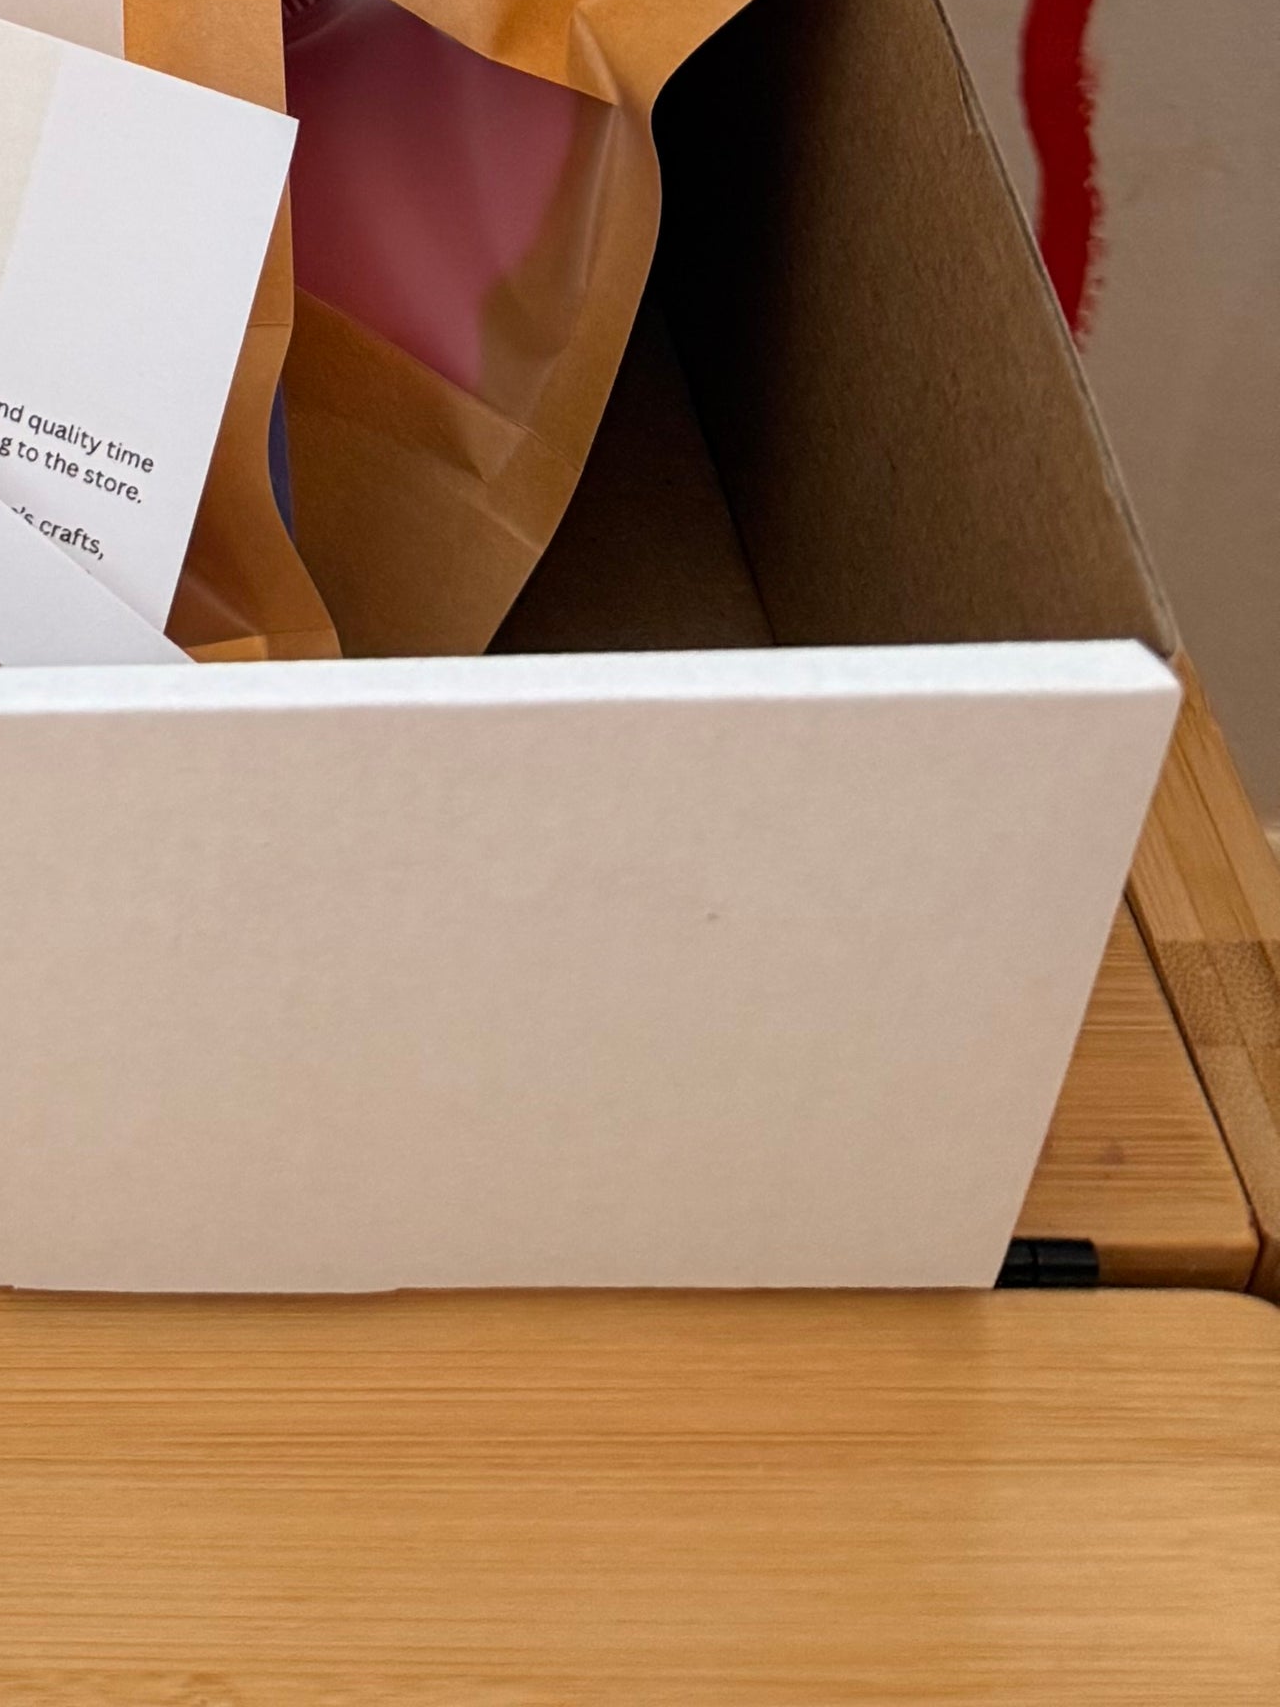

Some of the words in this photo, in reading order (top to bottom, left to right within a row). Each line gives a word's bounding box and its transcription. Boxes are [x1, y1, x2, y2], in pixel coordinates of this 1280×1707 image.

[17, 441, 39, 462] to
[44, 451, 79, 478] the
[82, 468, 141, 504] store.
[27, 414, 102, 456] quality
[106, 441, 154, 473] time
[38, 520, 104, 560] crafts,
